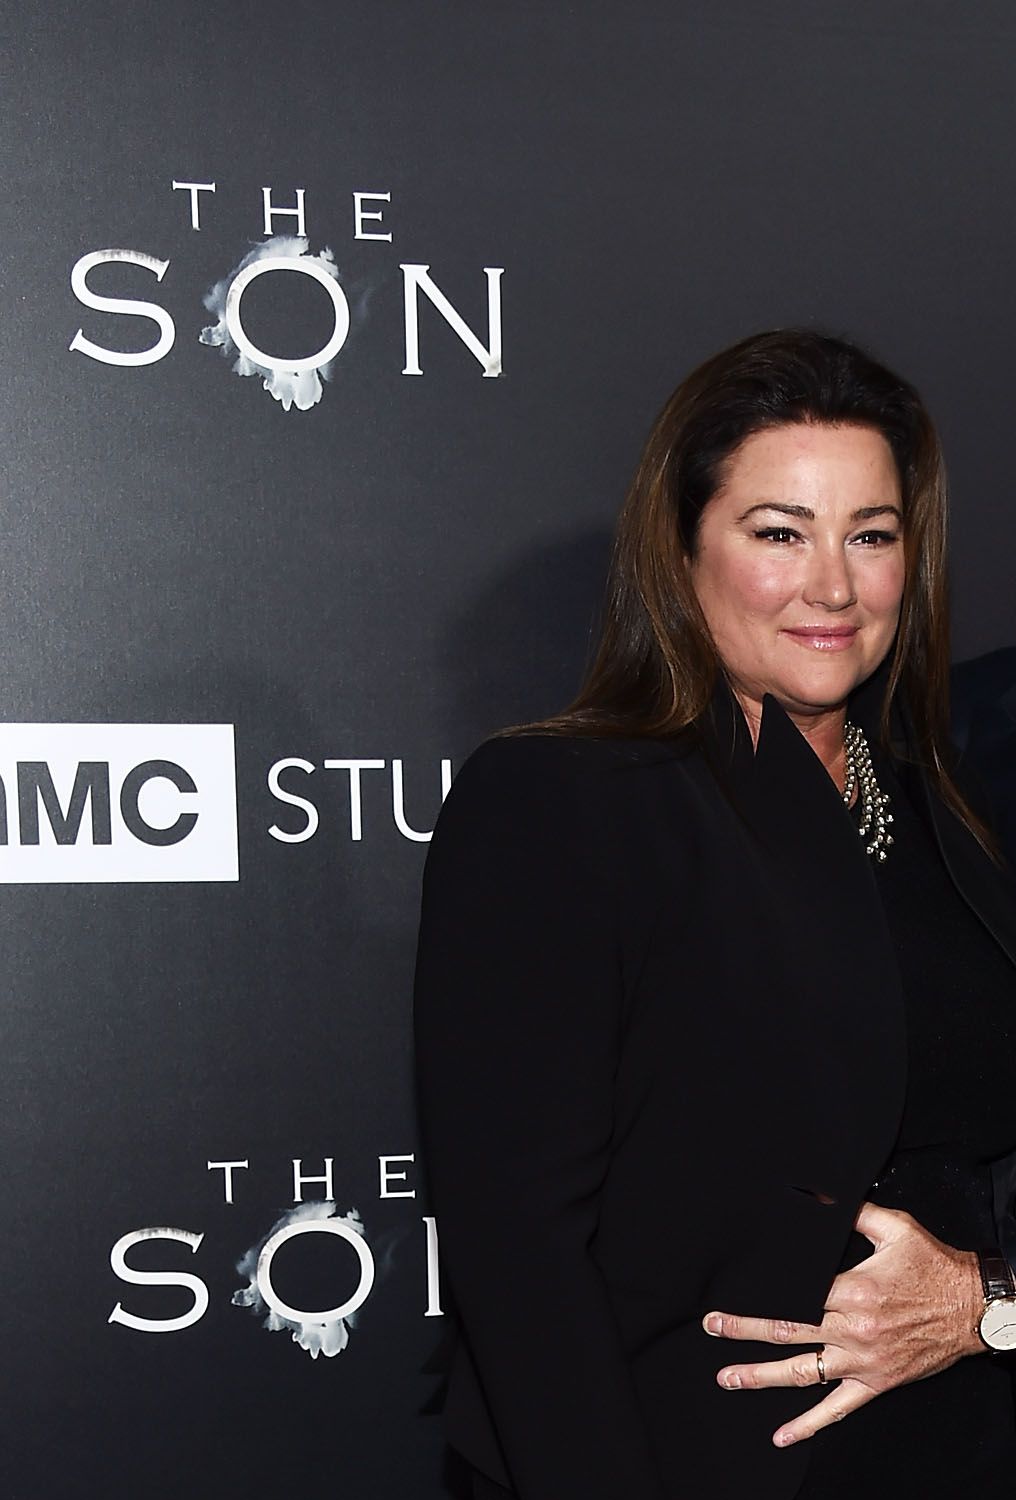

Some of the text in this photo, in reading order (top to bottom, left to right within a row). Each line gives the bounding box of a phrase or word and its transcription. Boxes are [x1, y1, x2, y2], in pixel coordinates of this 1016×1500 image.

[172, 180, 393, 243] THE
[69, 248, 505, 377] SON
[0, 759, 199, 846] MC
[208, 1154, 415, 1203] THE
